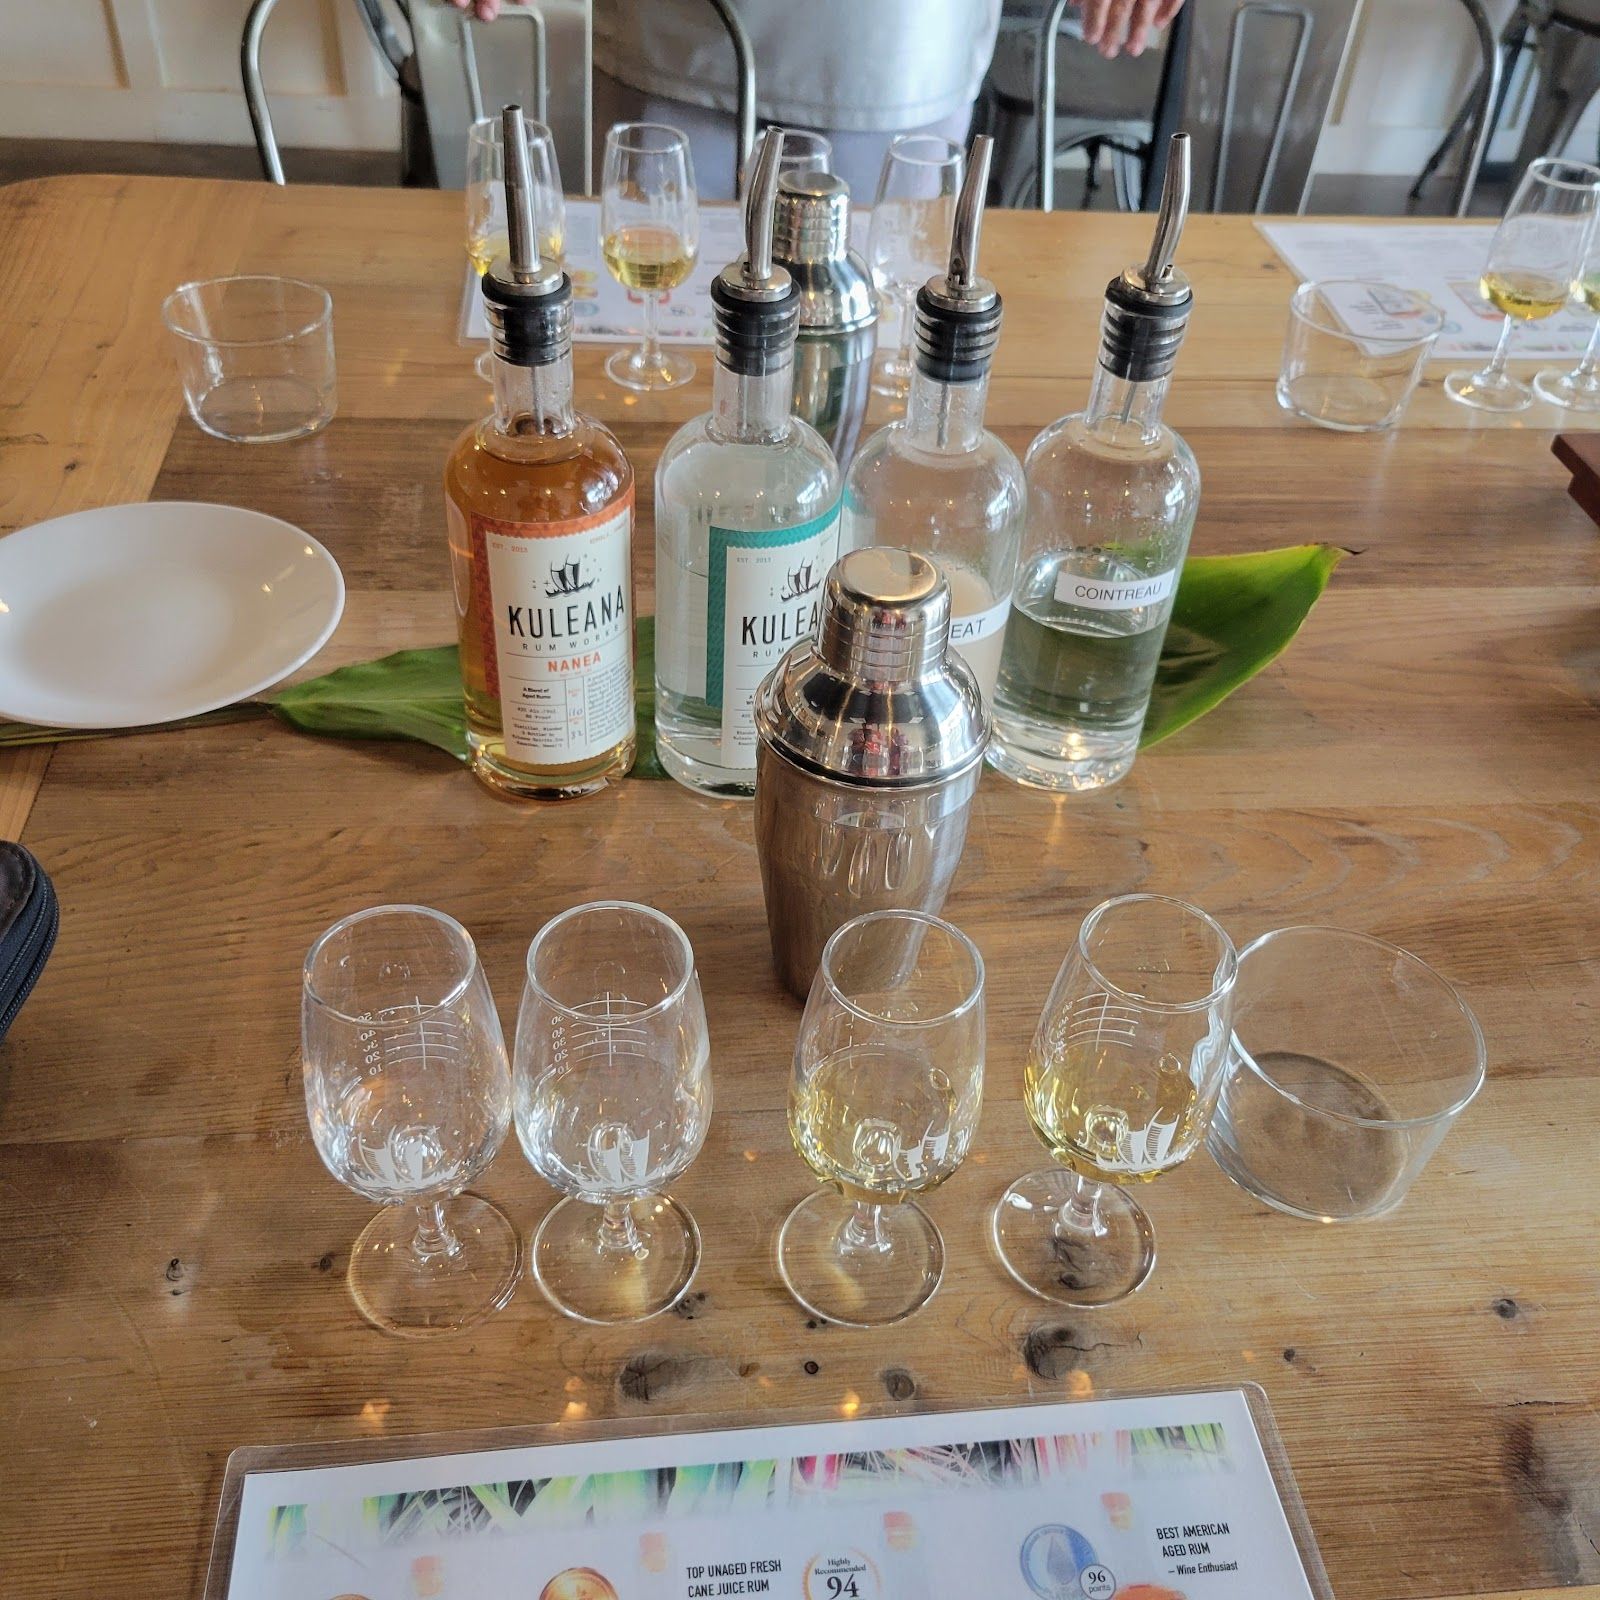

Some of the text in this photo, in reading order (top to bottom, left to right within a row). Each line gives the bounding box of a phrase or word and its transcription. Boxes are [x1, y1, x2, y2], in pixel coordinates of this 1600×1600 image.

[1075, 582, 1162, 601] COINTREAU
[508, 585, 624, 639] KULEANA
[742, 601, 818, 645] KULEA
[951, 617, 986, 639] EAT
[522, 624, 619, 651] RUM WORKS
[548, 651, 601, 672] NANEA
[753, 647, 784, 658] RUM
[1156, 1522, 1230, 1540] BEST AMERICAN
[1162, 1541, 1211, 1558] AGED RUM
[687, 1559, 782, 1579] TOP UNAGED FRESH
[814, 1564, 867, 1576] Recommended
[827, 1558, 851, 1567] Highly
[1176, 1564, 1196, 1575] Wine
[1197, 1560, 1238, 1573] Enthusiast
[826, 1573, 860, 1600] 94
[1088, 1570, 1106, 1585] 96
[688, 1579, 770, 1598] CANE JUICE RUM
[1089, 1584, 1111, 1594] points
